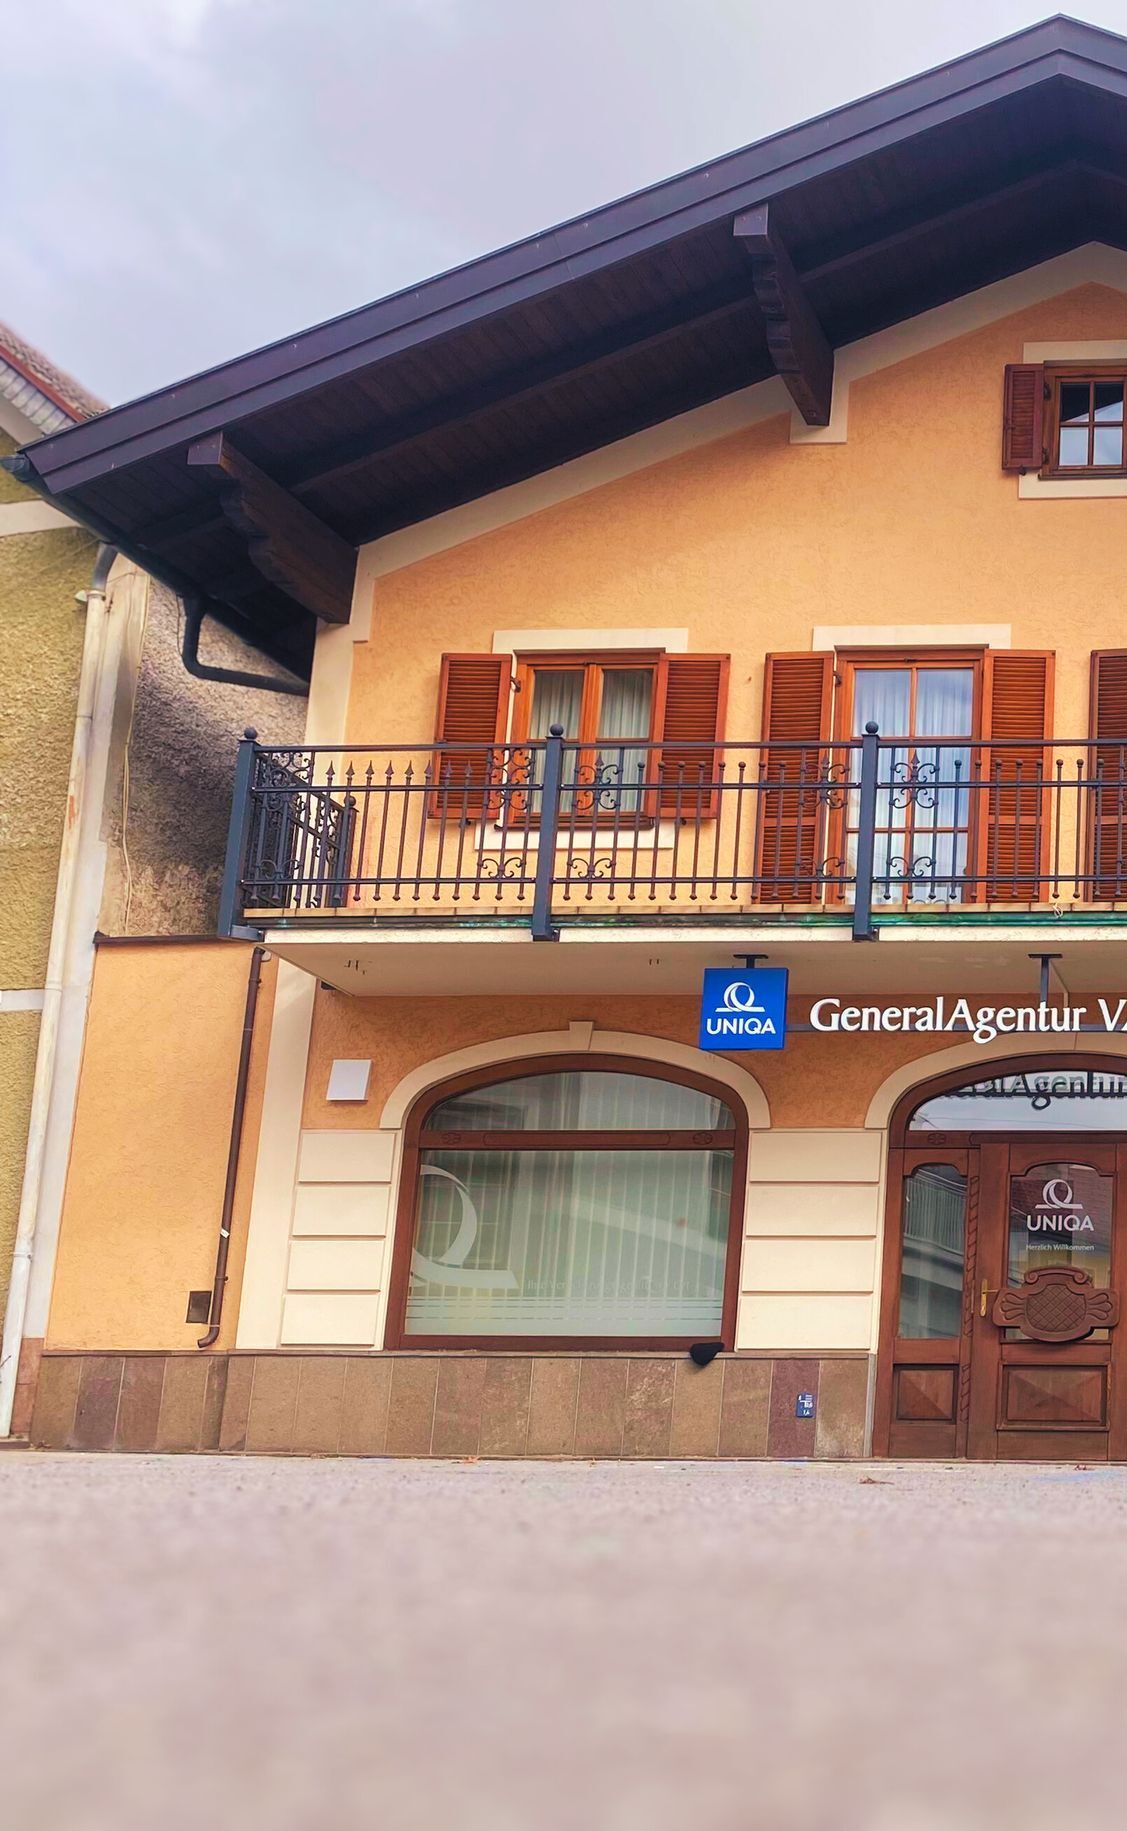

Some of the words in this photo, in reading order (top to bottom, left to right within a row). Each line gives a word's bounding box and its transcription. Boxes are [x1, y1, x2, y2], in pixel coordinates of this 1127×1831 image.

[706, 1017, 776, 1035] UNIQA
[809, 996, 1087, 1044] GeneralAgentur
[1026, 1214, 1095, 1232] UNIQA
[1026, 1243, 1053, 1252] Herzlich
[1053, 1243, 1095, 1252] Willkommen
